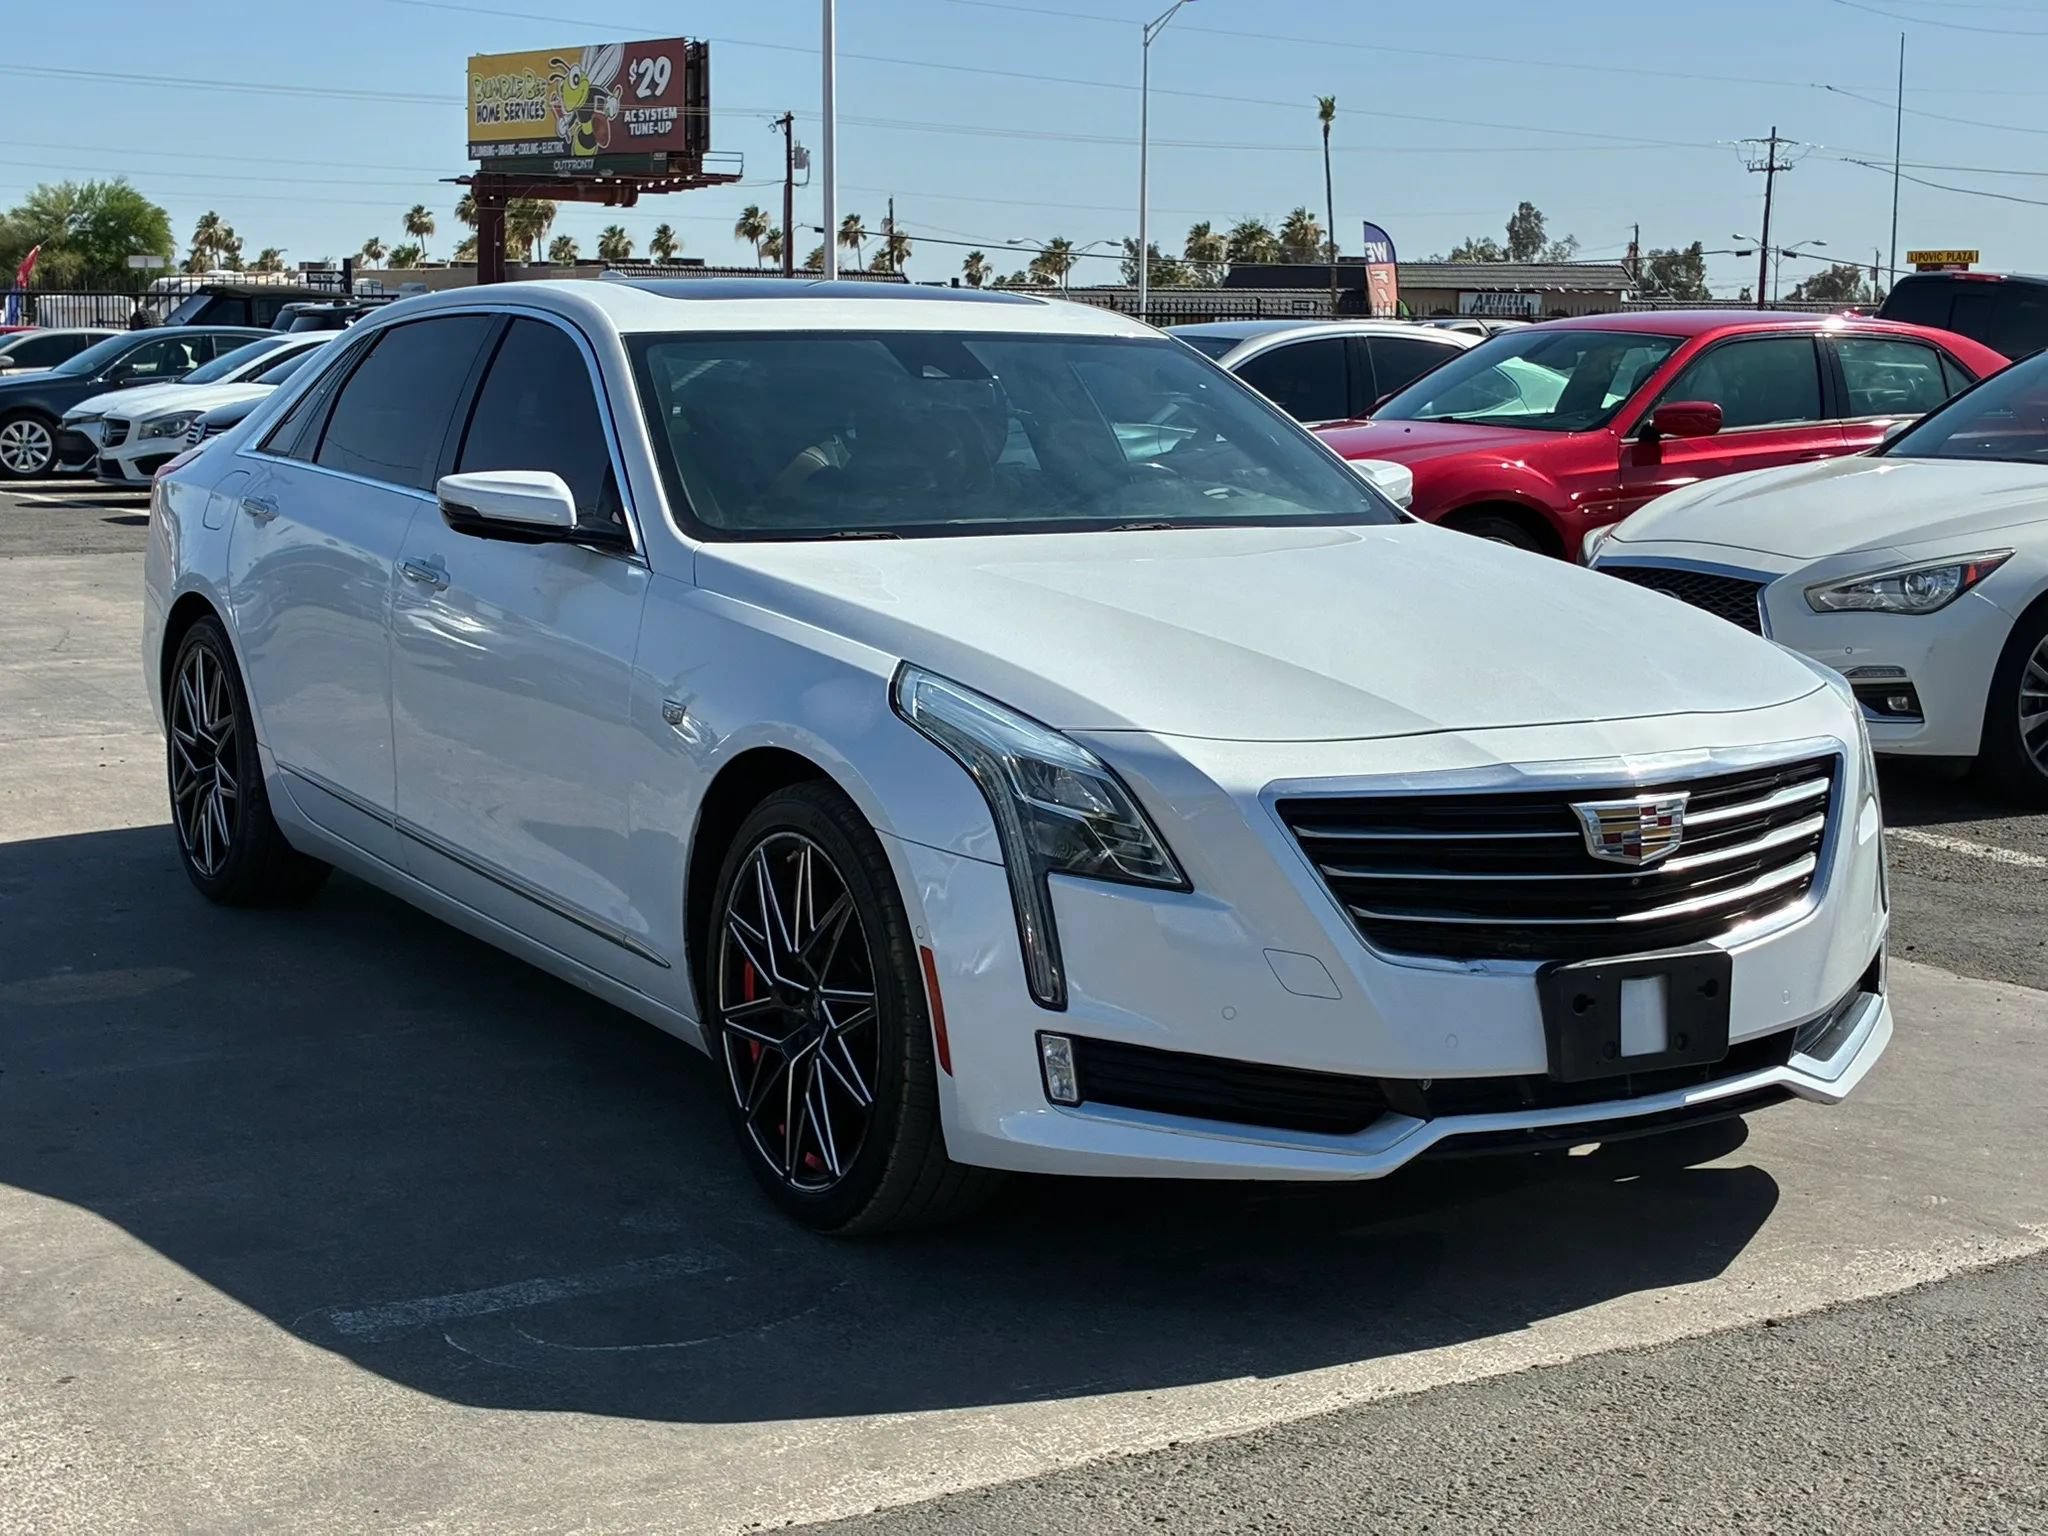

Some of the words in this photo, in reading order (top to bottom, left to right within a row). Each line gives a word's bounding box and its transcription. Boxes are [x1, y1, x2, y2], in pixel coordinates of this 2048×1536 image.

[629, 56, 671, 98] $29
[476, 103, 500, 123] HOME
[504, 101, 546, 121] SERVICES
[624, 110, 637, 123] AC
[638, 107, 677, 121] SYSTEM
[629, 121, 672, 136] TUNE-UP
[1946, 252, 1973, 262] PLAZA
[1470, 293, 1526, 312] AMERICAN
